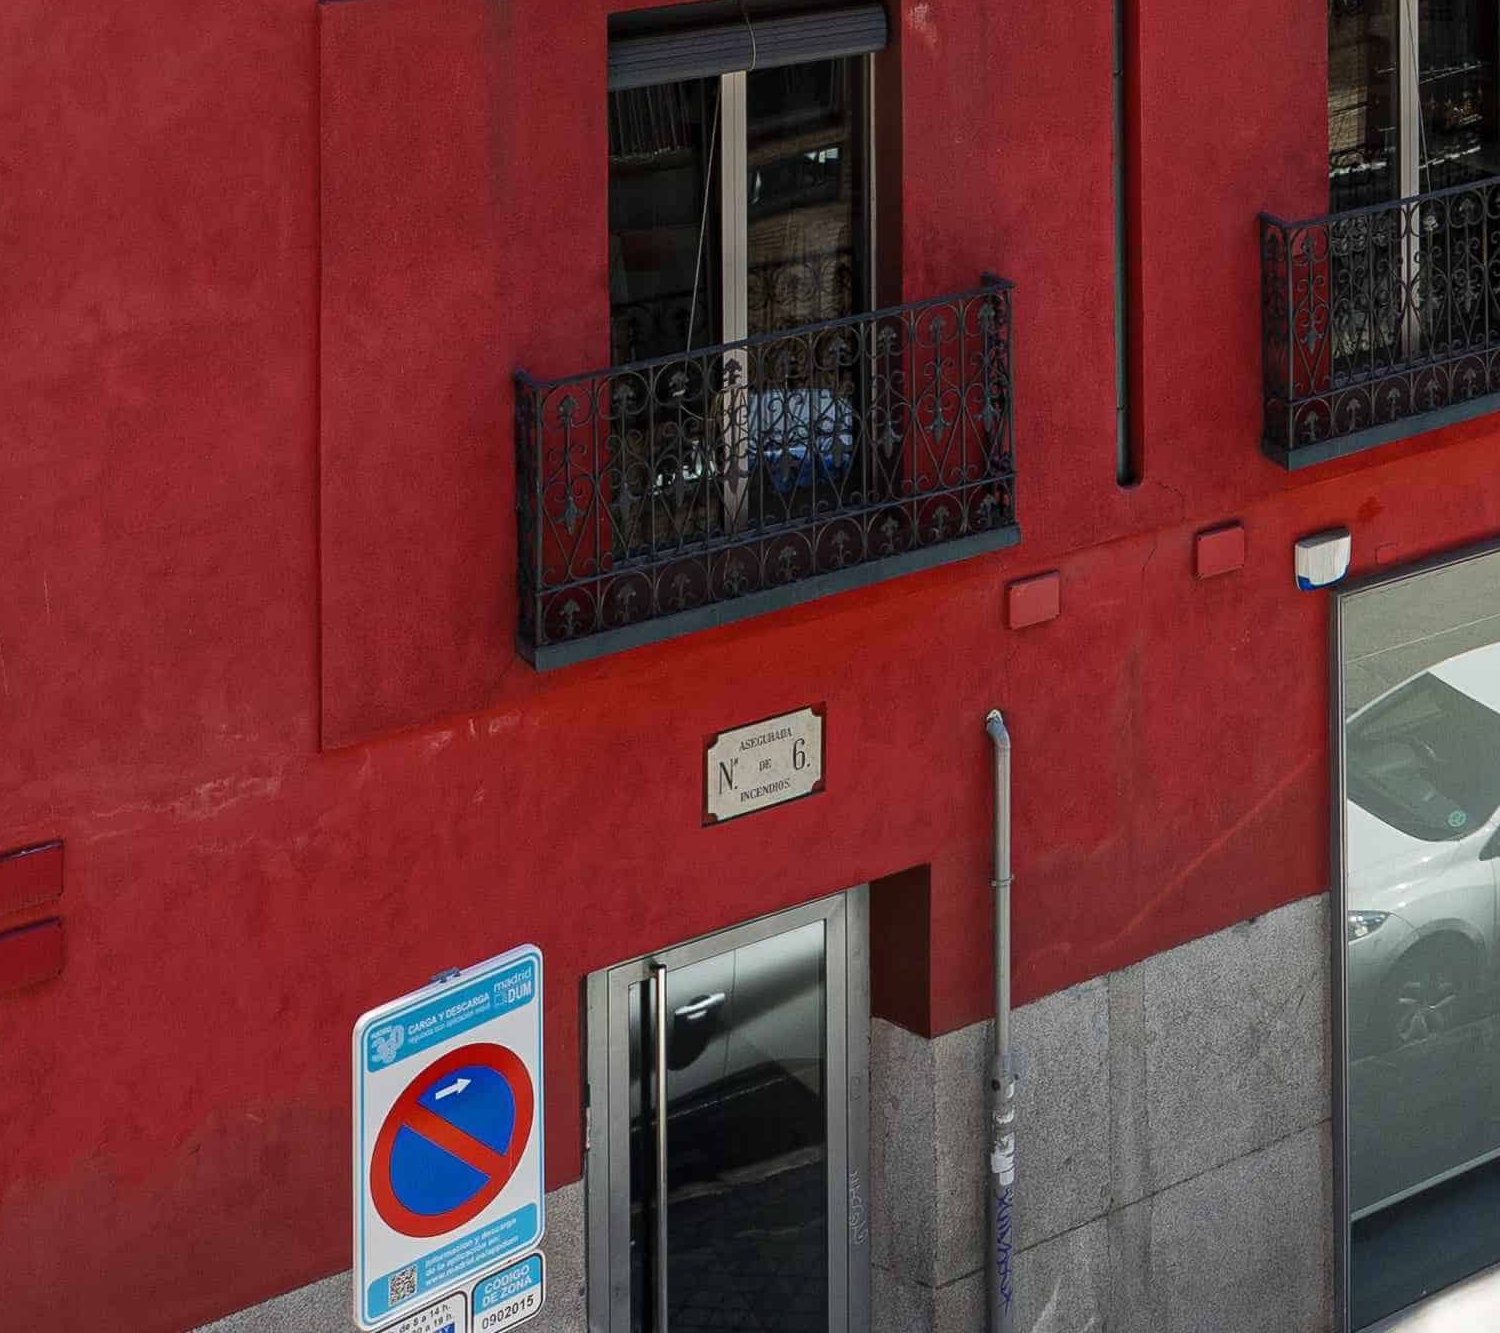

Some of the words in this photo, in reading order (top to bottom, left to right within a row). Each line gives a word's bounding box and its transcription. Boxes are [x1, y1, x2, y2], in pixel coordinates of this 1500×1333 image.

[758, 758, 772, 772] DE
[494, 966, 532, 993] madrid
[507, 981, 532, 1004] DUM
[408, 1016, 437, 1035] CARGA
[438, 1012, 444, 1023] Y
[445, 992, 490, 1019] DESCARGA
[482, 1294, 499, 1309] DE
[500, 1275, 533, 1300] ZONA
[481, 1294, 535, 1330] 0902015
